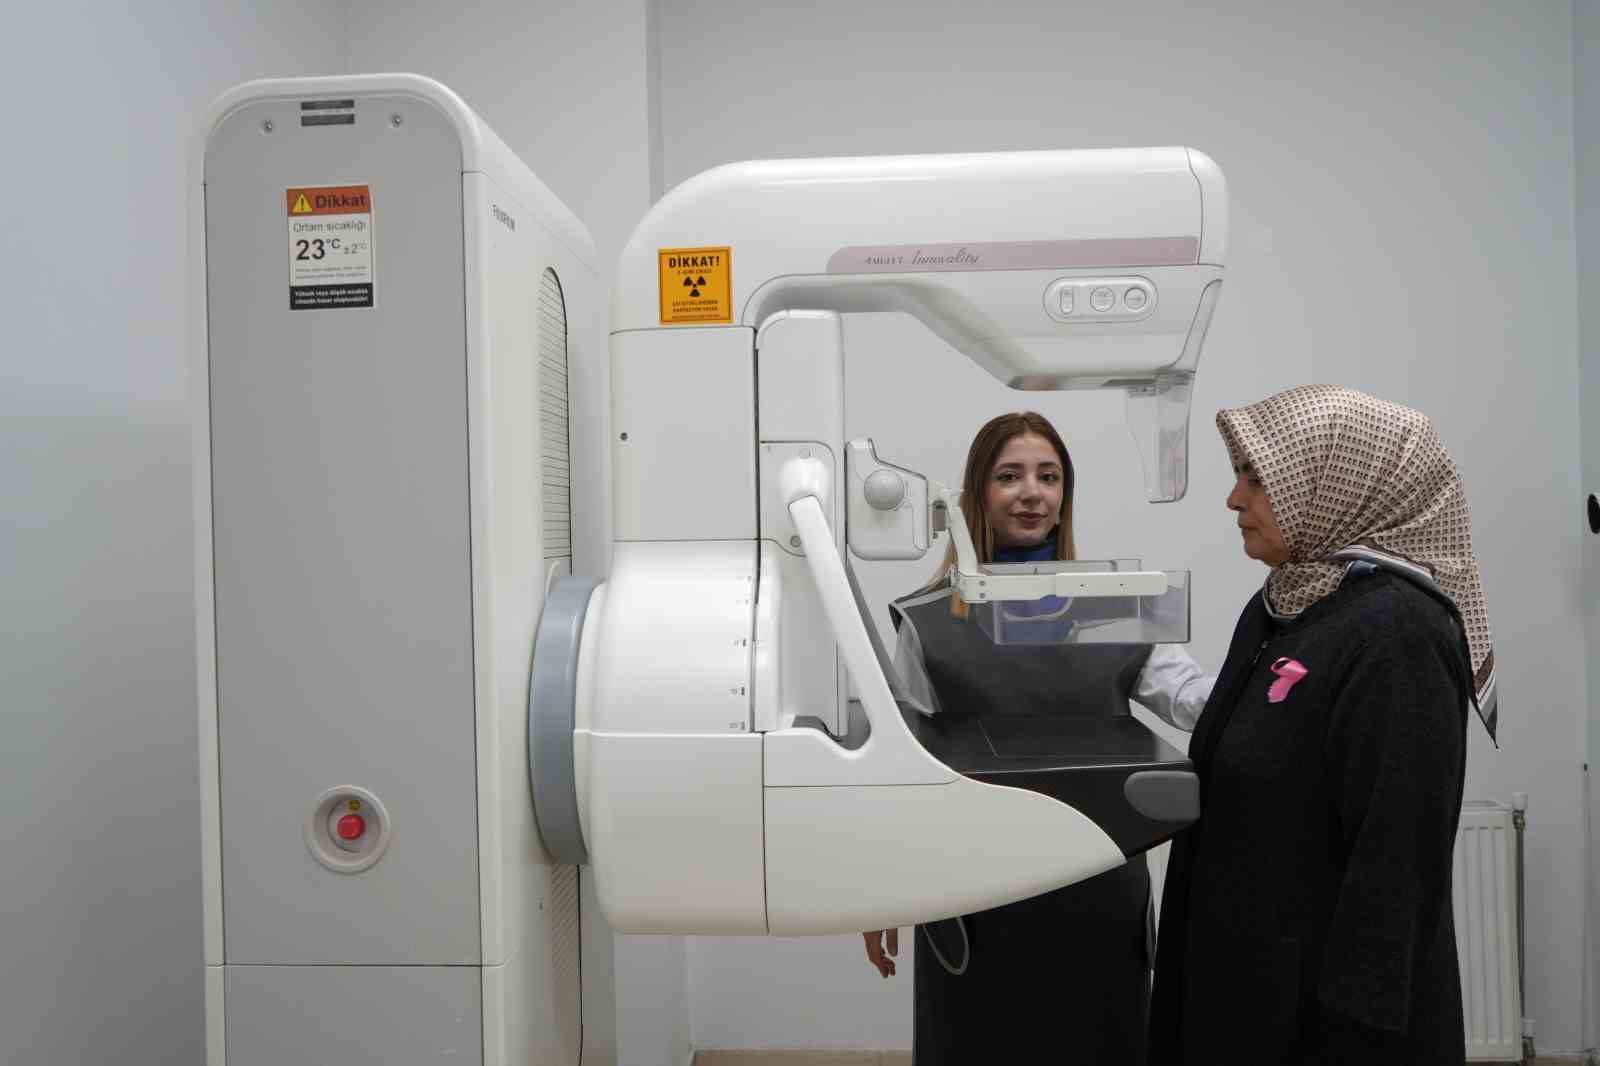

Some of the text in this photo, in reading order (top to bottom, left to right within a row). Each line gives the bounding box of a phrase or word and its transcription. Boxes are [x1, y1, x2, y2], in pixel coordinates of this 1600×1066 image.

[315, 194, 366, 209] Dikkat
[293, 222, 324, 233] Ortam
[668, 255, 720, 269] DİKKAT!
